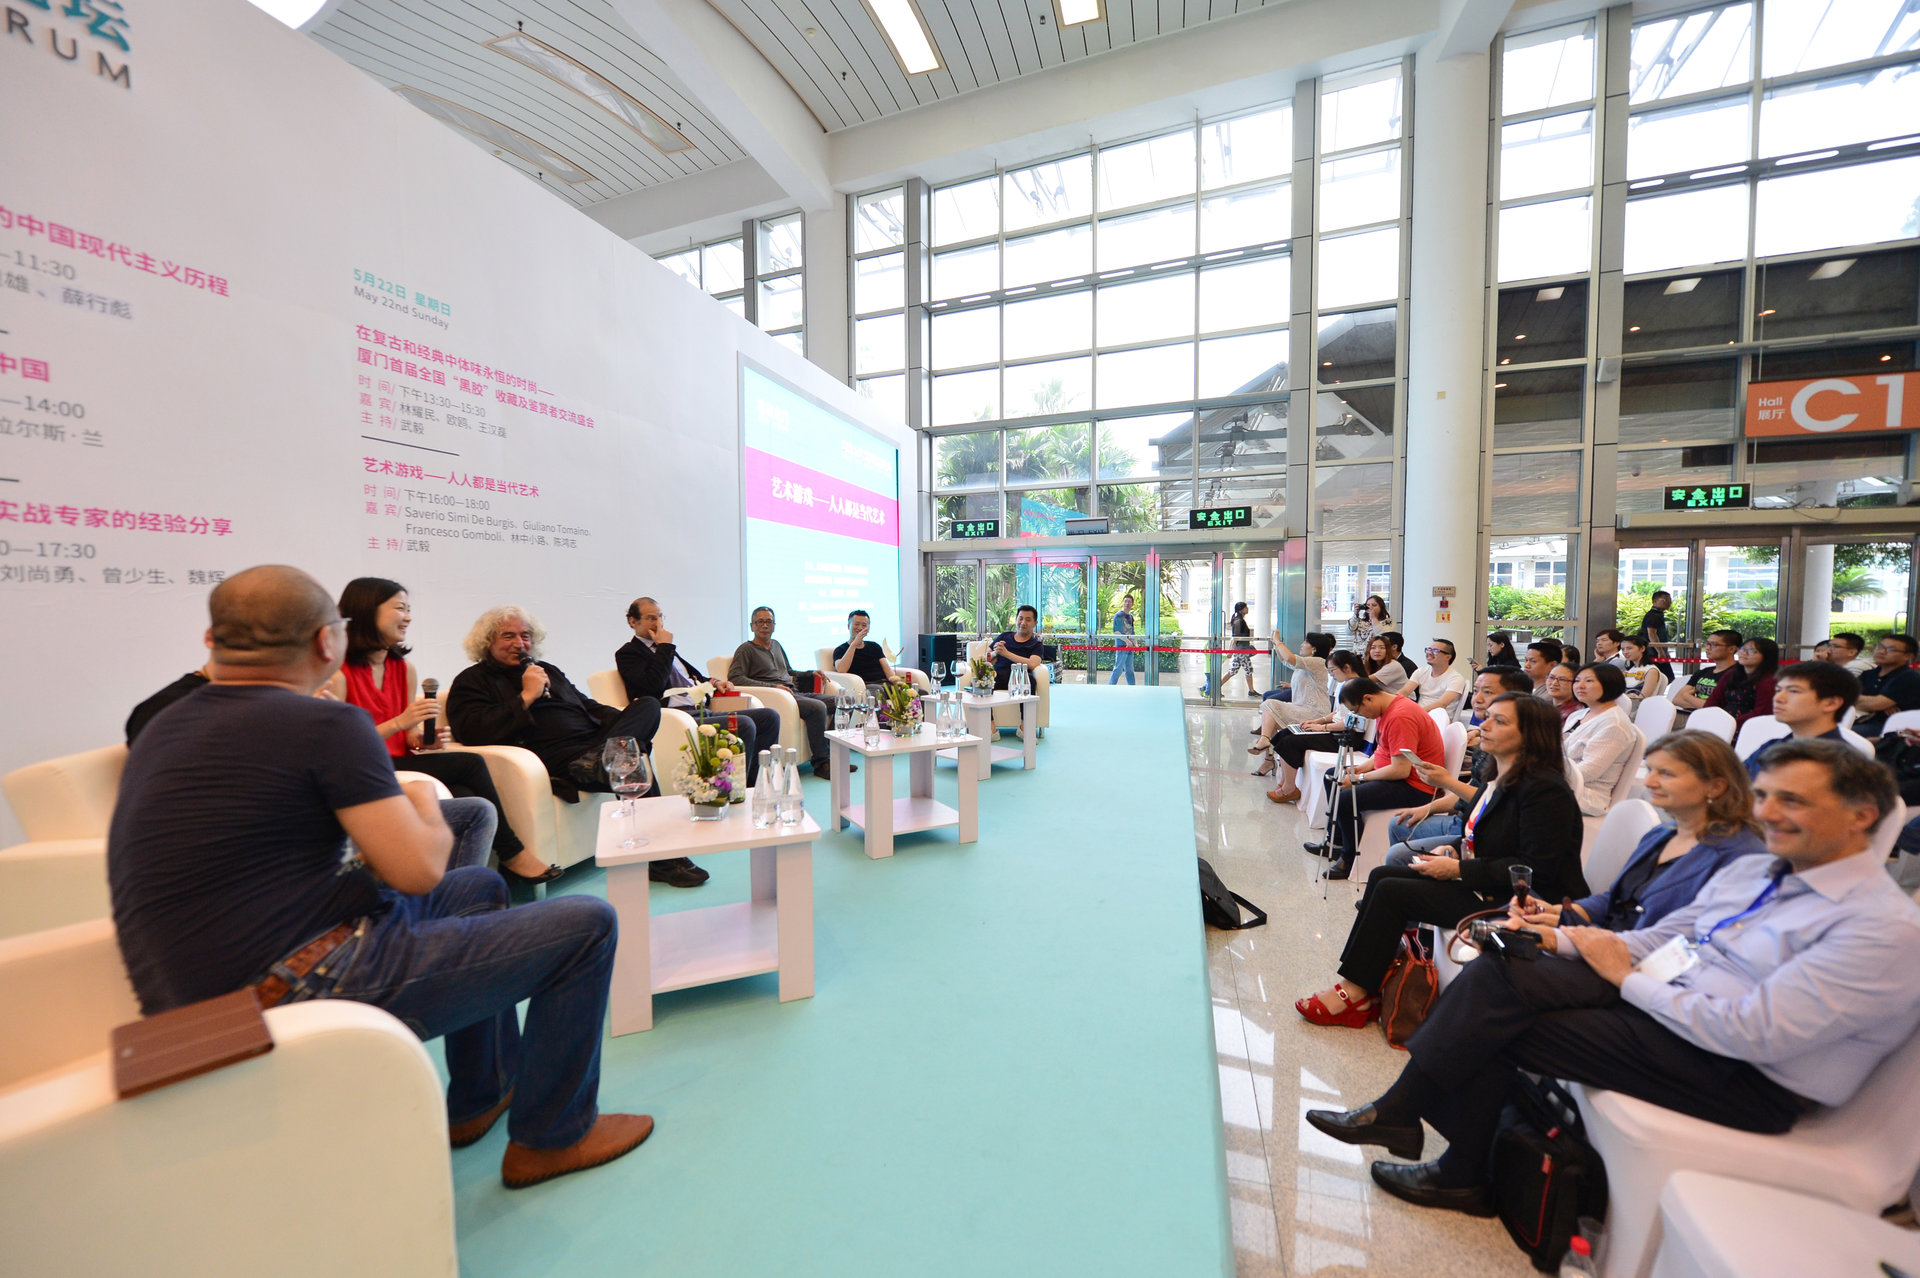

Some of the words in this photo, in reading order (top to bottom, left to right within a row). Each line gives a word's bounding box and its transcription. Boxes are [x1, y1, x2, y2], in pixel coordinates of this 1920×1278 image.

[5, 6, 131, 90] RUM
[353, 268, 407, 299] 5月22日
[415, 291, 451, 317] 星期日
[354, 286, 378, 304] May
[382, 296, 409, 314] 22nd
[412, 307, 449, 330] Sunday
[1758, 397, 1783, 408] Hall
[1791, 374, 1905, 432] C1
[1758, 408, 1785, 421] 展厅
[1671, 486, 1743, 501] 安全出口
[1687, 498, 1726, 507] EXIT
[0, 500, 233, 536] 实战专家的经验分享
[405, 506, 445, 521] Saverio
[448, 511, 470, 524] Simi
[471, 514, 485, 526] De
[522, 520, 556, 533] Giuliano
[1196, 509, 1245, 522] 安全出口
[1207, 519, 1233, 527] EXIT
[406, 523, 460, 539] Francesco
[956, 521, 994, 532] 安全出口
